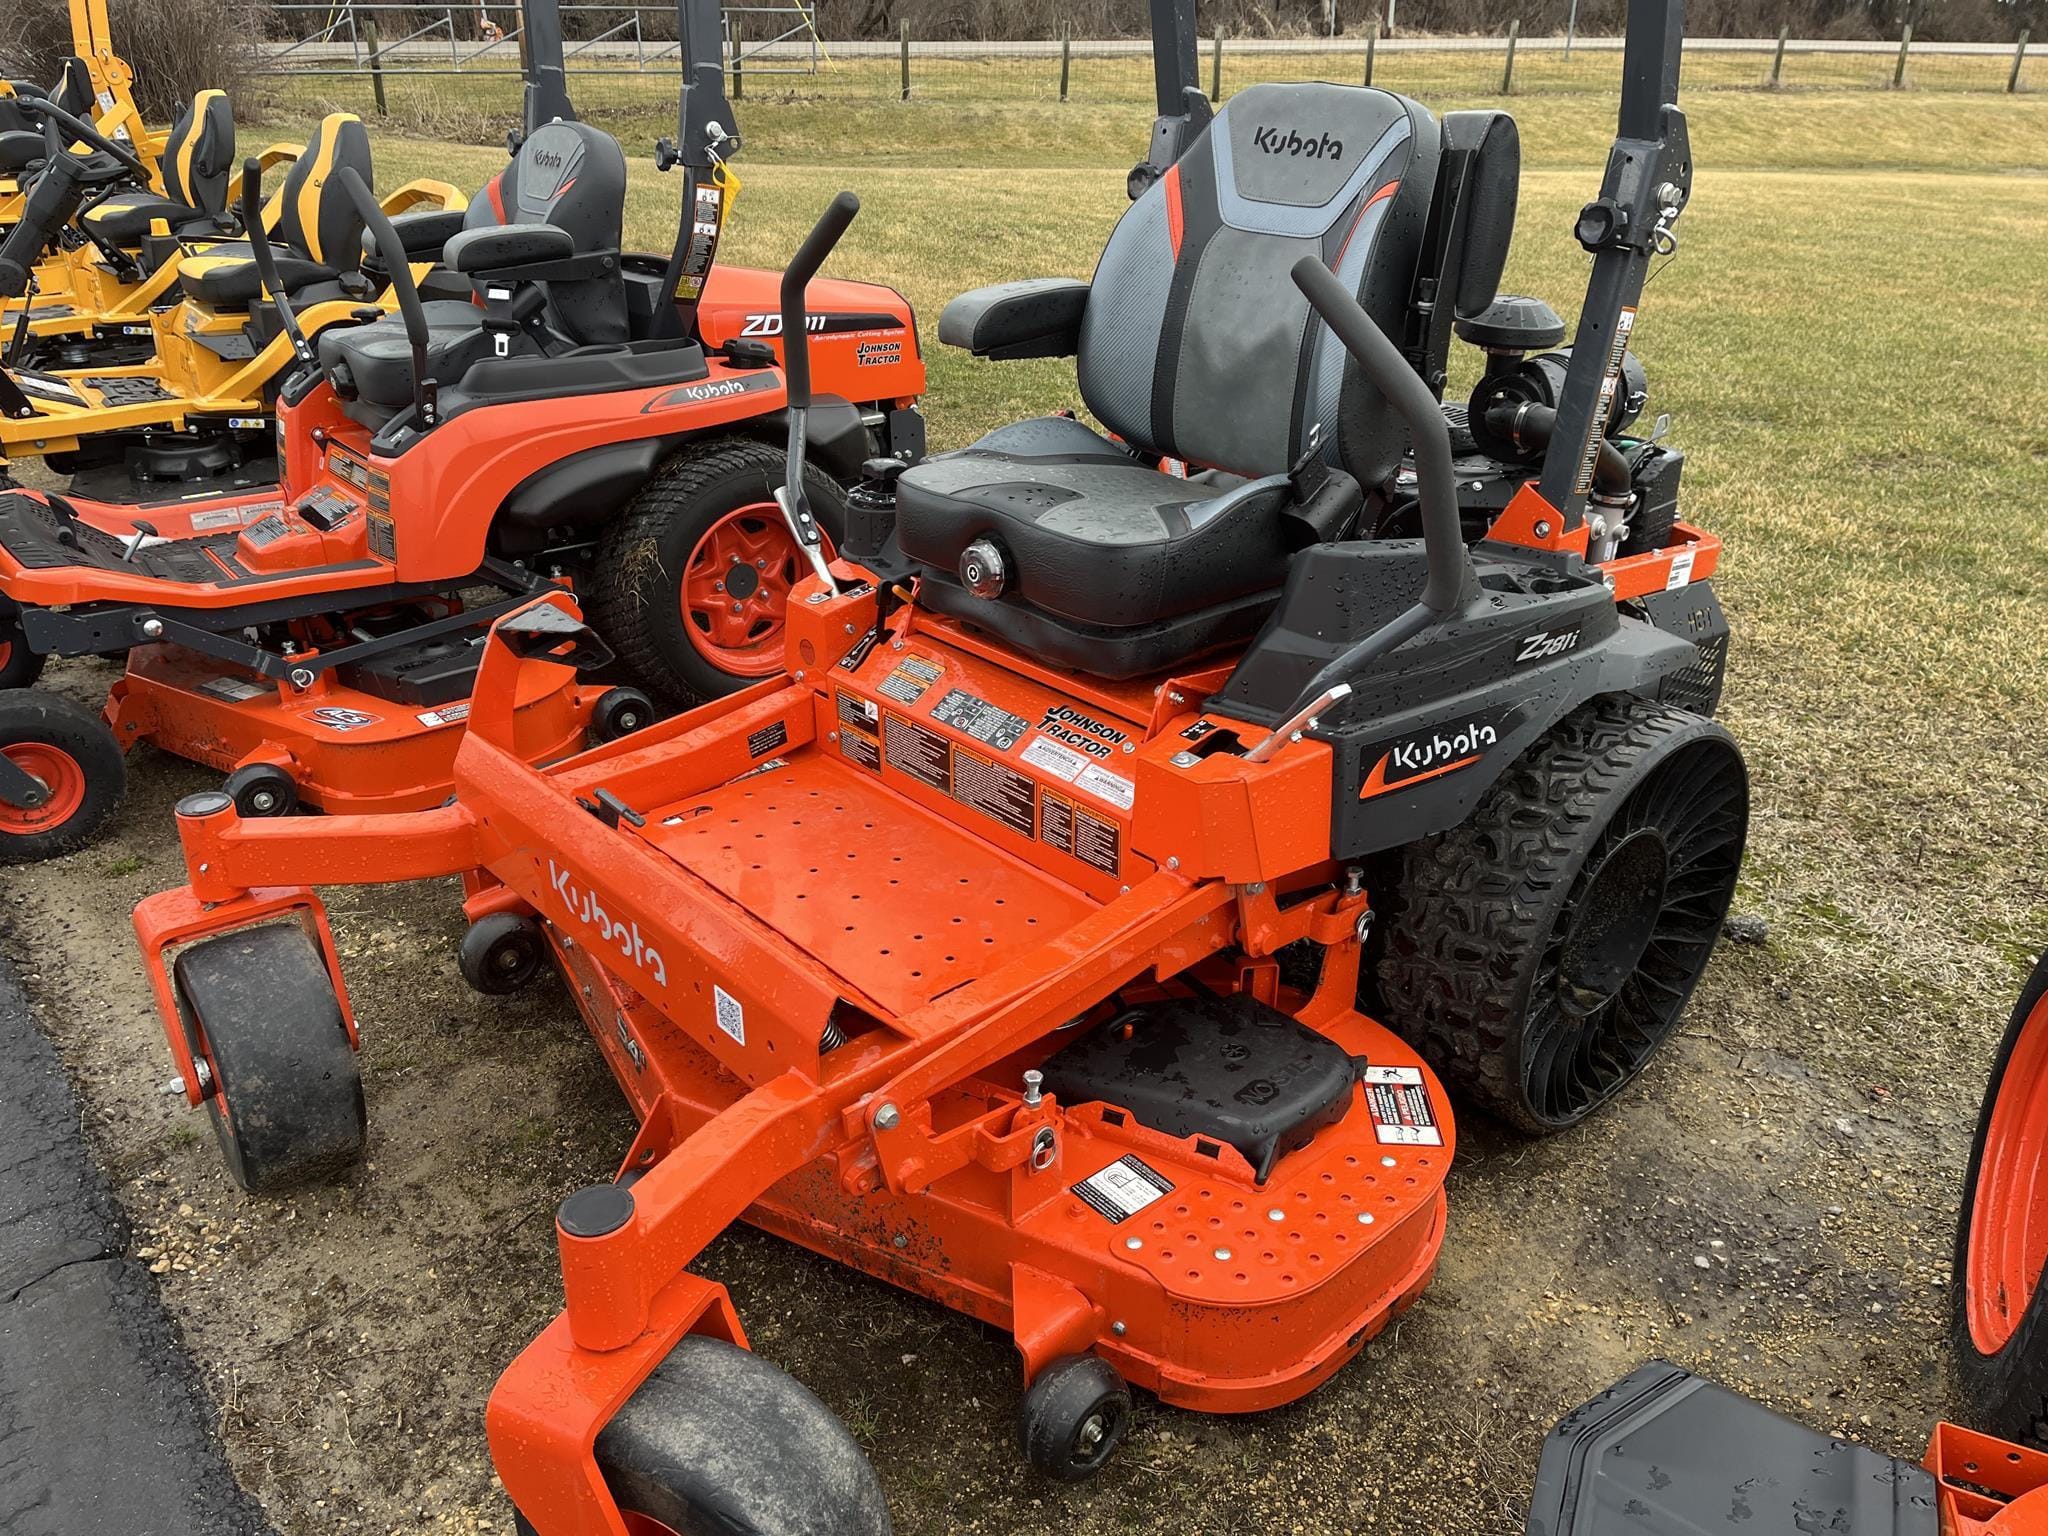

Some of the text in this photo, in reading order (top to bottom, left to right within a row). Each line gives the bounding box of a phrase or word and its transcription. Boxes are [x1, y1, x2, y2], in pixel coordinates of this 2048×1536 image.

[1253, 125, 1344, 161] Kubota
[534, 148, 562, 168] Kubota
[857, 341, 901, 354] JOHNSON
[858, 354, 901, 366] TRACTOR
[686, 380, 745, 400] Kubota
[324, 709, 370, 723] ACS
[1047, 705, 1127, 744] JOHNSON
[1036, 715, 1112, 758] TRACTOR
[1393, 723, 1497, 769] Kubota
[549, 858, 667, 987] Kubota
[1240, 1082, 1274, 1106] NO
